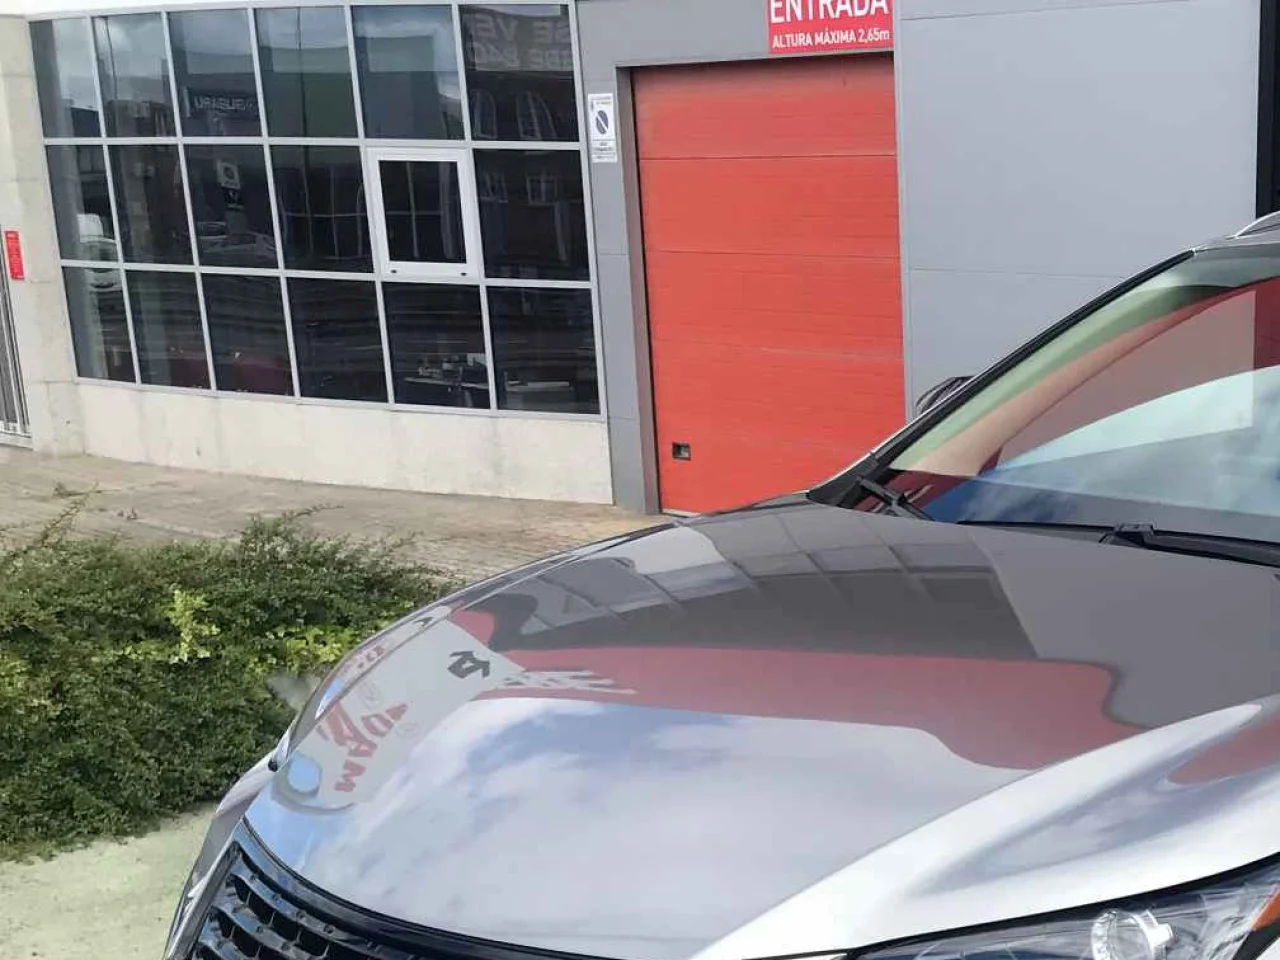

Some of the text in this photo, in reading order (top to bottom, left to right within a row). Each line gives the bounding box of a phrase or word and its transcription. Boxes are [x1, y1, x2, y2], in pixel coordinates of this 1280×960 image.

[770, 0, 889, 24] ENTRADA
[772, 33, 813, 48] ALTURA
[814, 27, 857, 46] MÁXIMA
